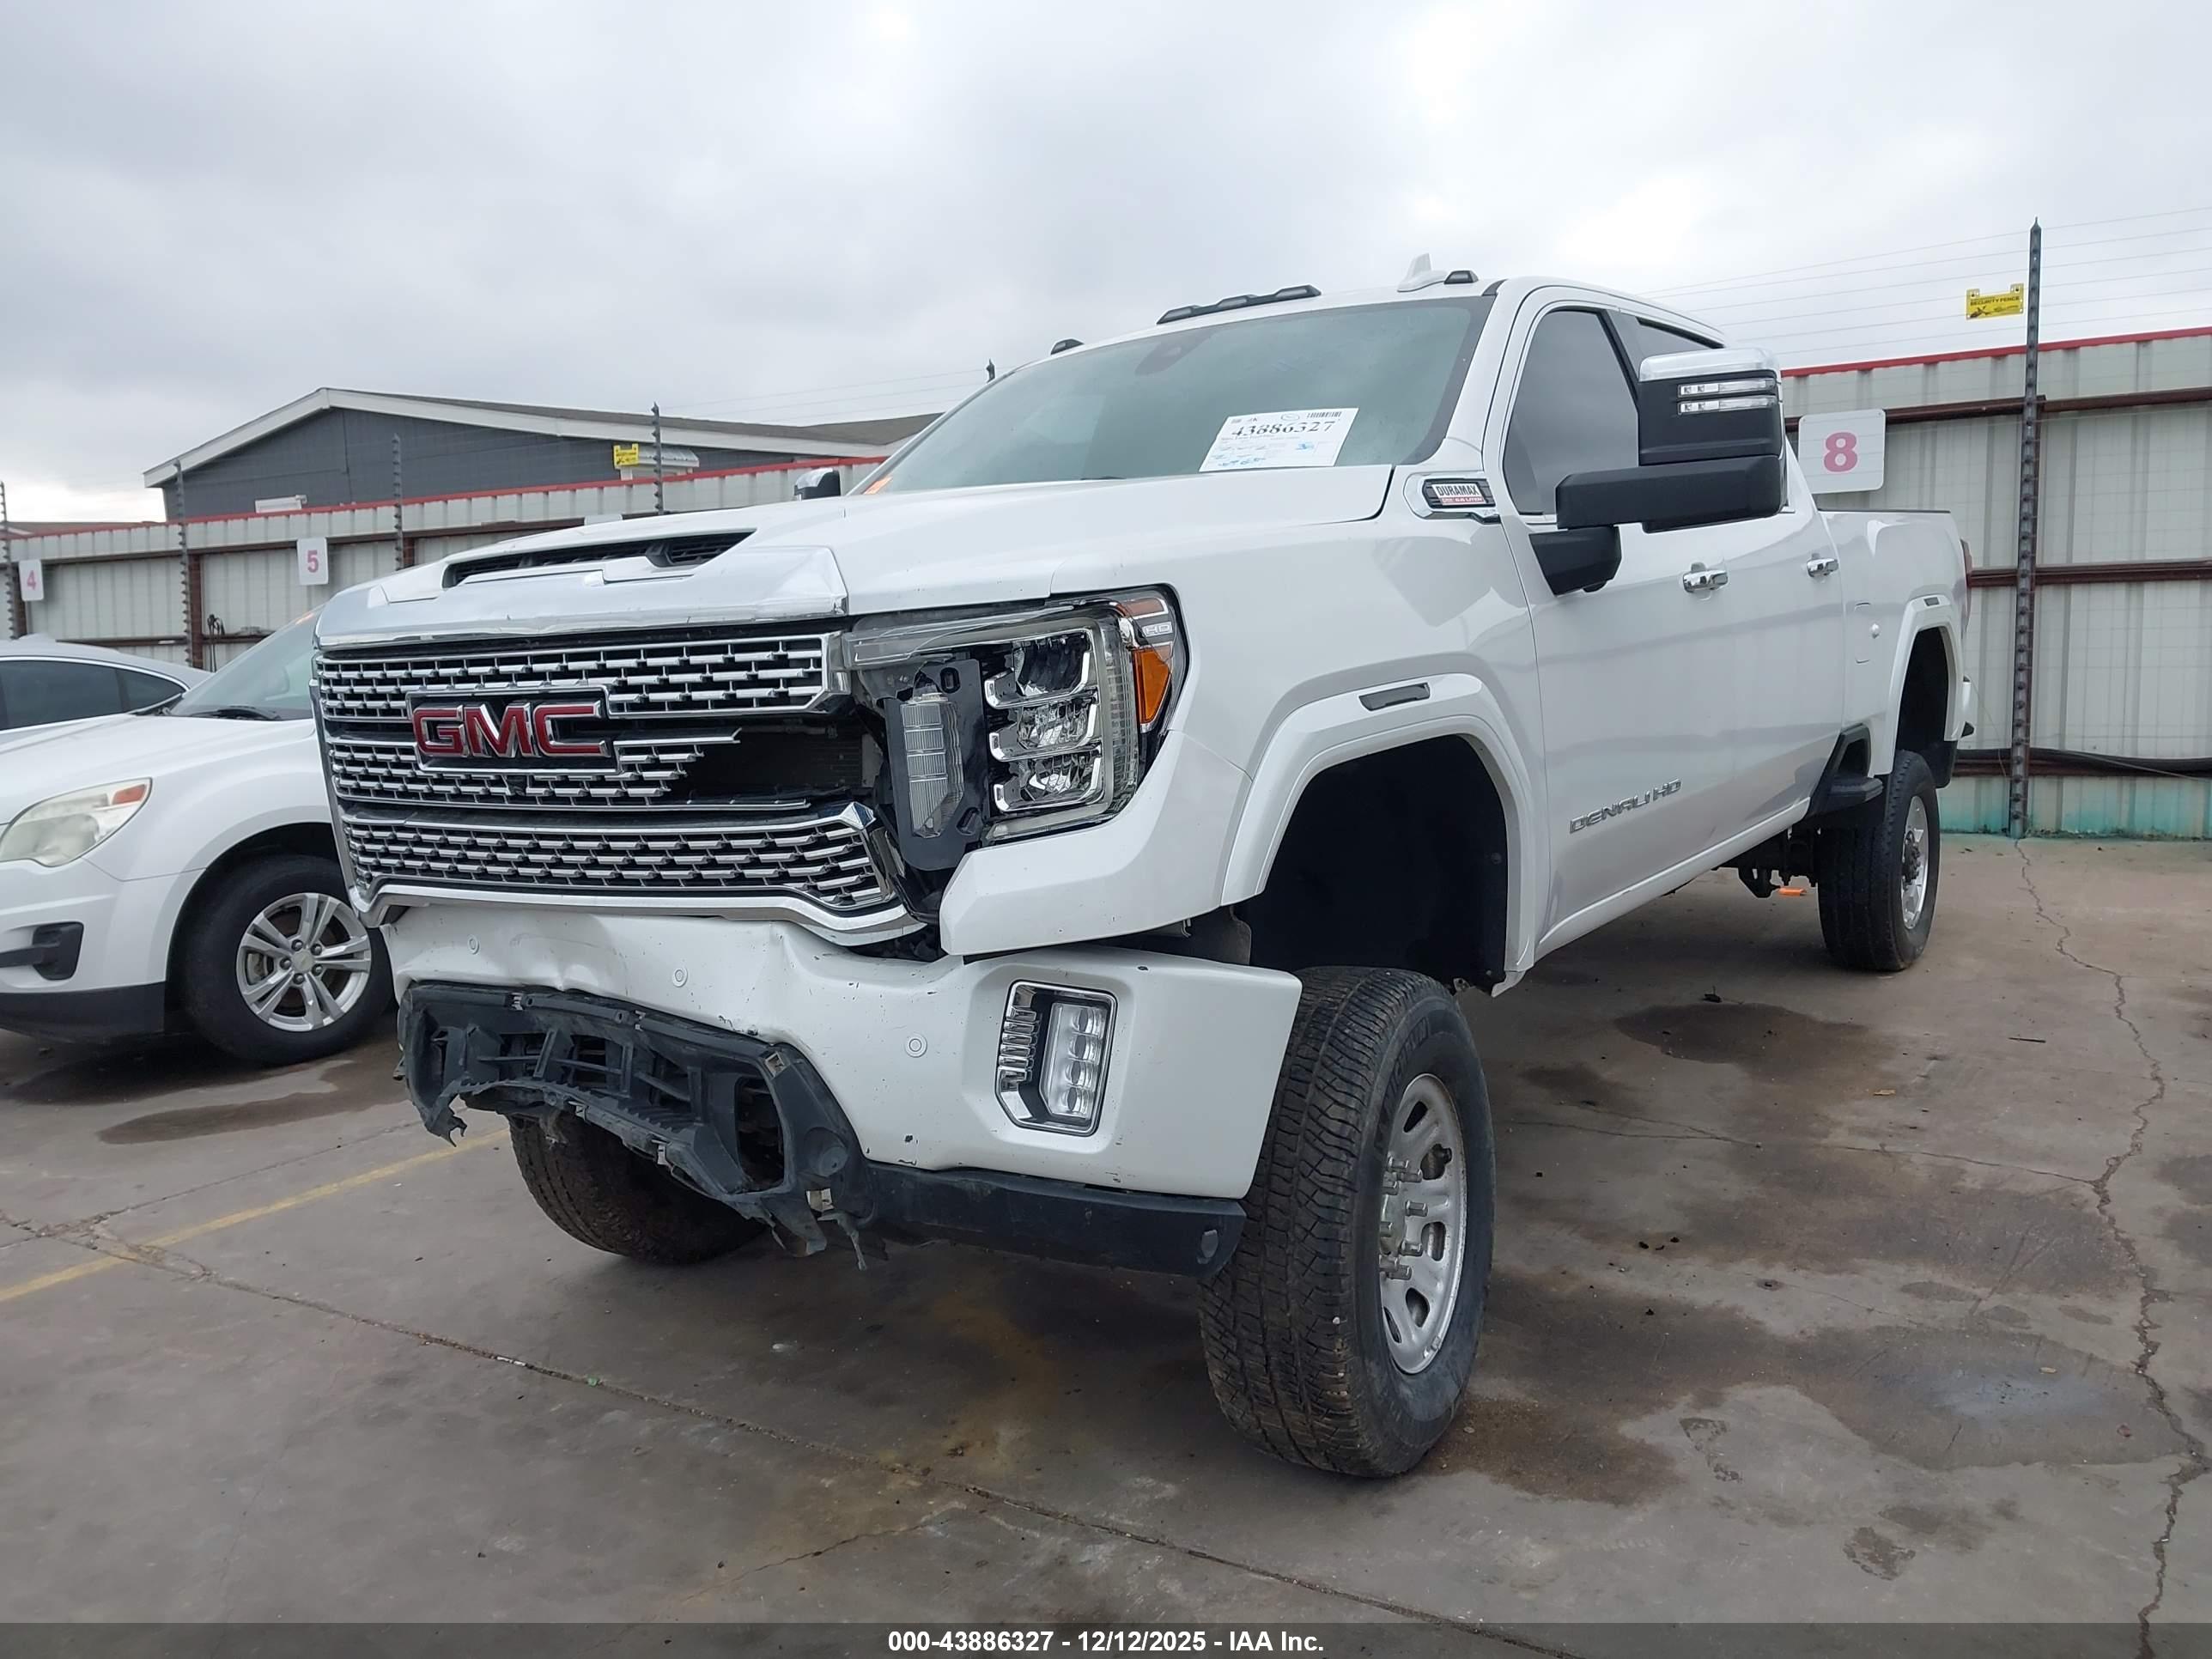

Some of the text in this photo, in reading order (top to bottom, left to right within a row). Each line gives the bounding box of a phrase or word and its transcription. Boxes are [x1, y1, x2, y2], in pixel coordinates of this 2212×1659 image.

[1231, 421, 1336, 437] 43886327
[1823, 431, 1858, 473] 8
[1436, 485, 1480, 496] DURAMAX
[307, 550, 319, 574] 5
[27, 570, 37, 591] 4
[412, 701, 611, 757] GMC
[1570, 778, 1681, 834] DENALI HD
